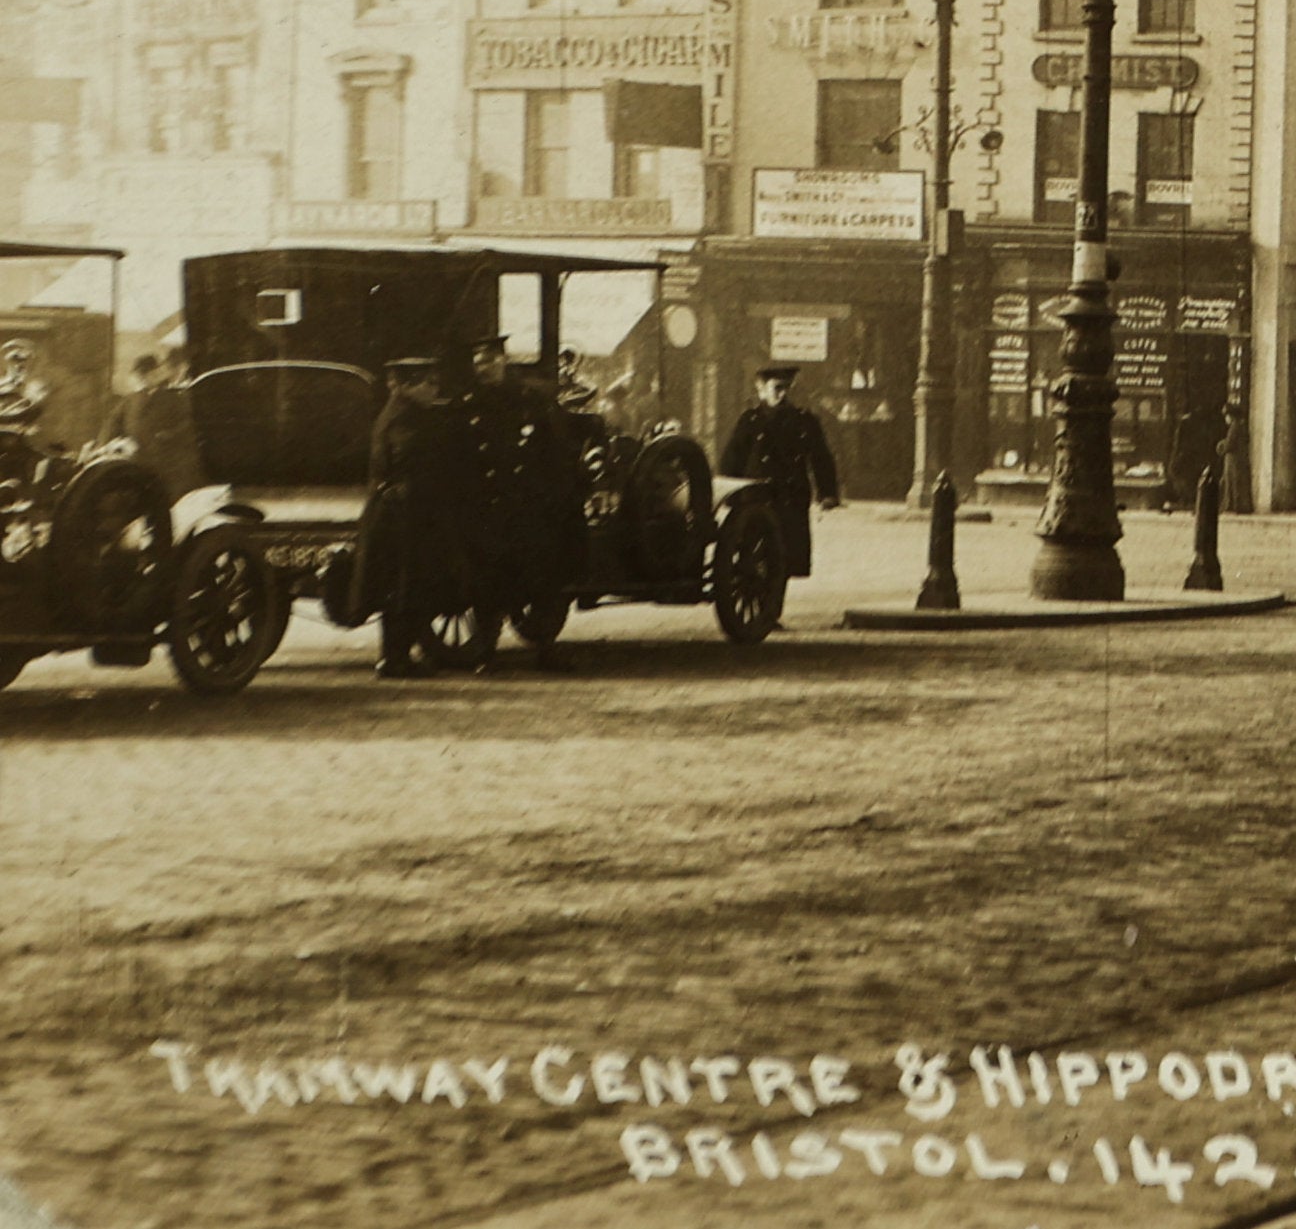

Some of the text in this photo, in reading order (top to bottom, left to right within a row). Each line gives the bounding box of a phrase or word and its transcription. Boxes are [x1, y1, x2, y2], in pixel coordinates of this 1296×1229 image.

[480, 35, 600, 70] TOBACCO
[1047, 58, 1181, 82] CHMIST
[759, 212, 838, 226] FURNITURE
[849, 213, 916, 228] CARPETS
